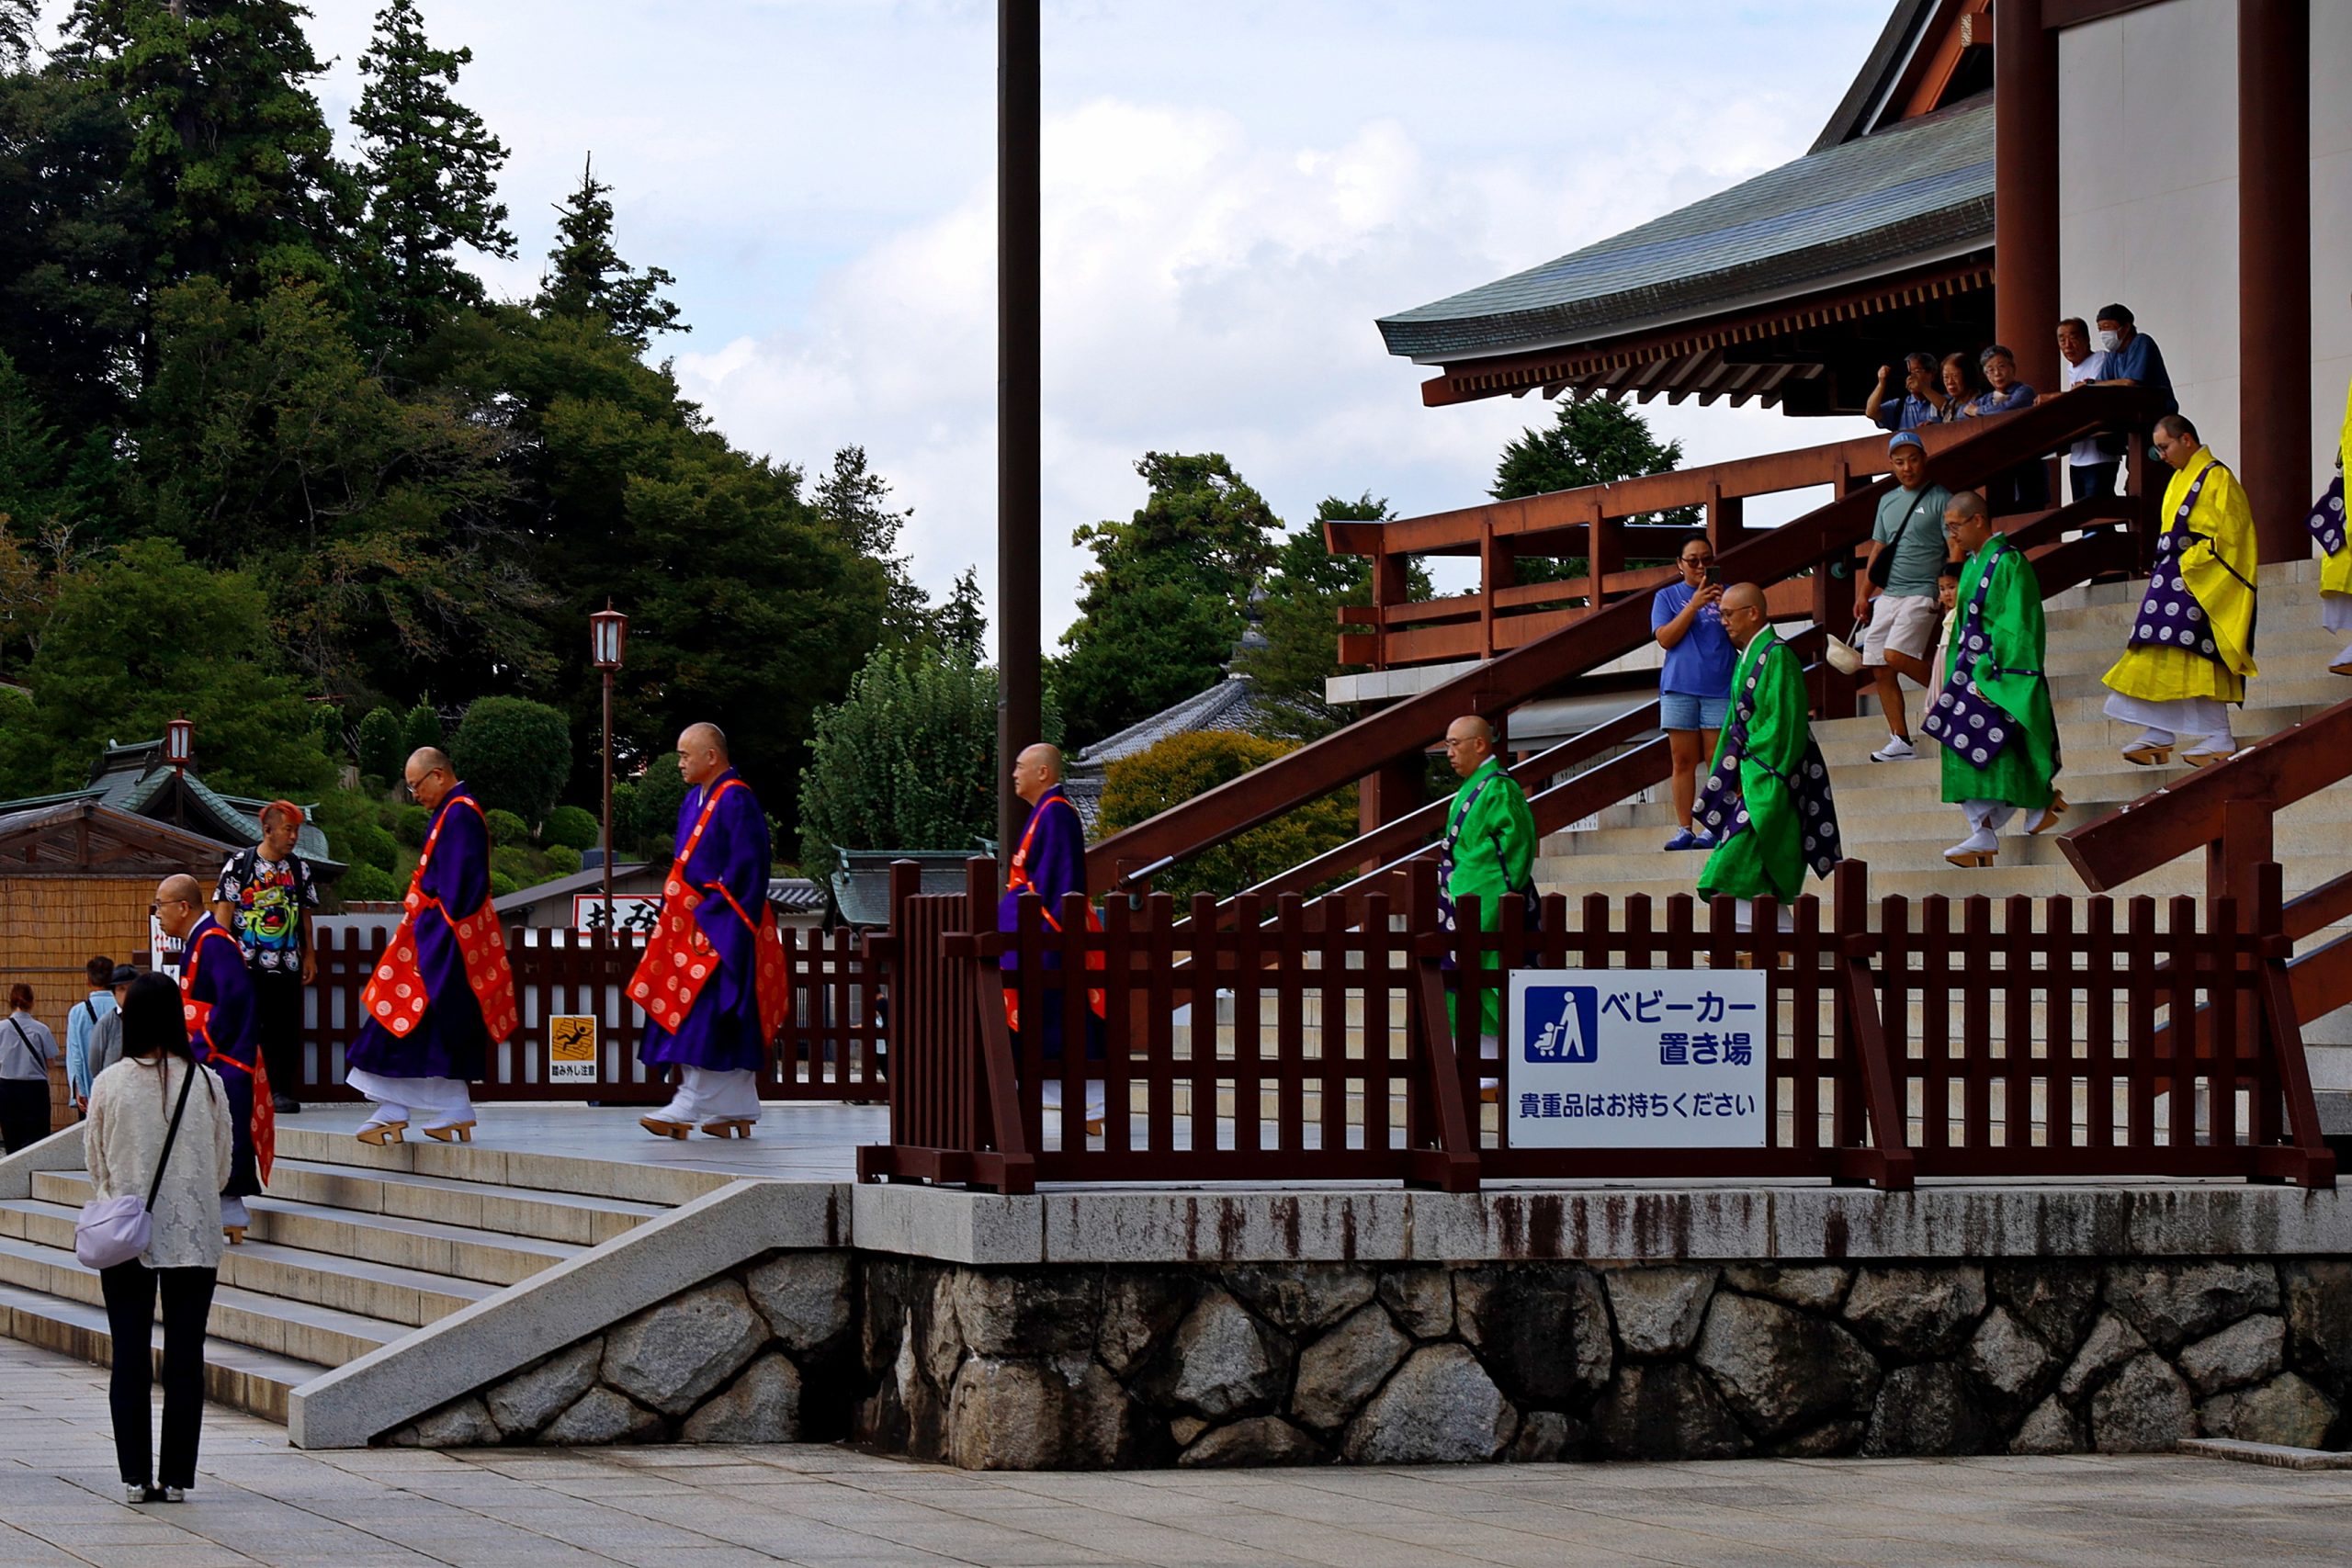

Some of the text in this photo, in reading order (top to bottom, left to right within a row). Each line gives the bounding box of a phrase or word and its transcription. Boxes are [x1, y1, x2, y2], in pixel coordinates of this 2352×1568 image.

[1601, 989, 1756, 1023] ベビーカー
[1659, 1032, 1752, 1066] 置き場
[1520, 1092, 1755, 1118] 貴重品はお持ちください
